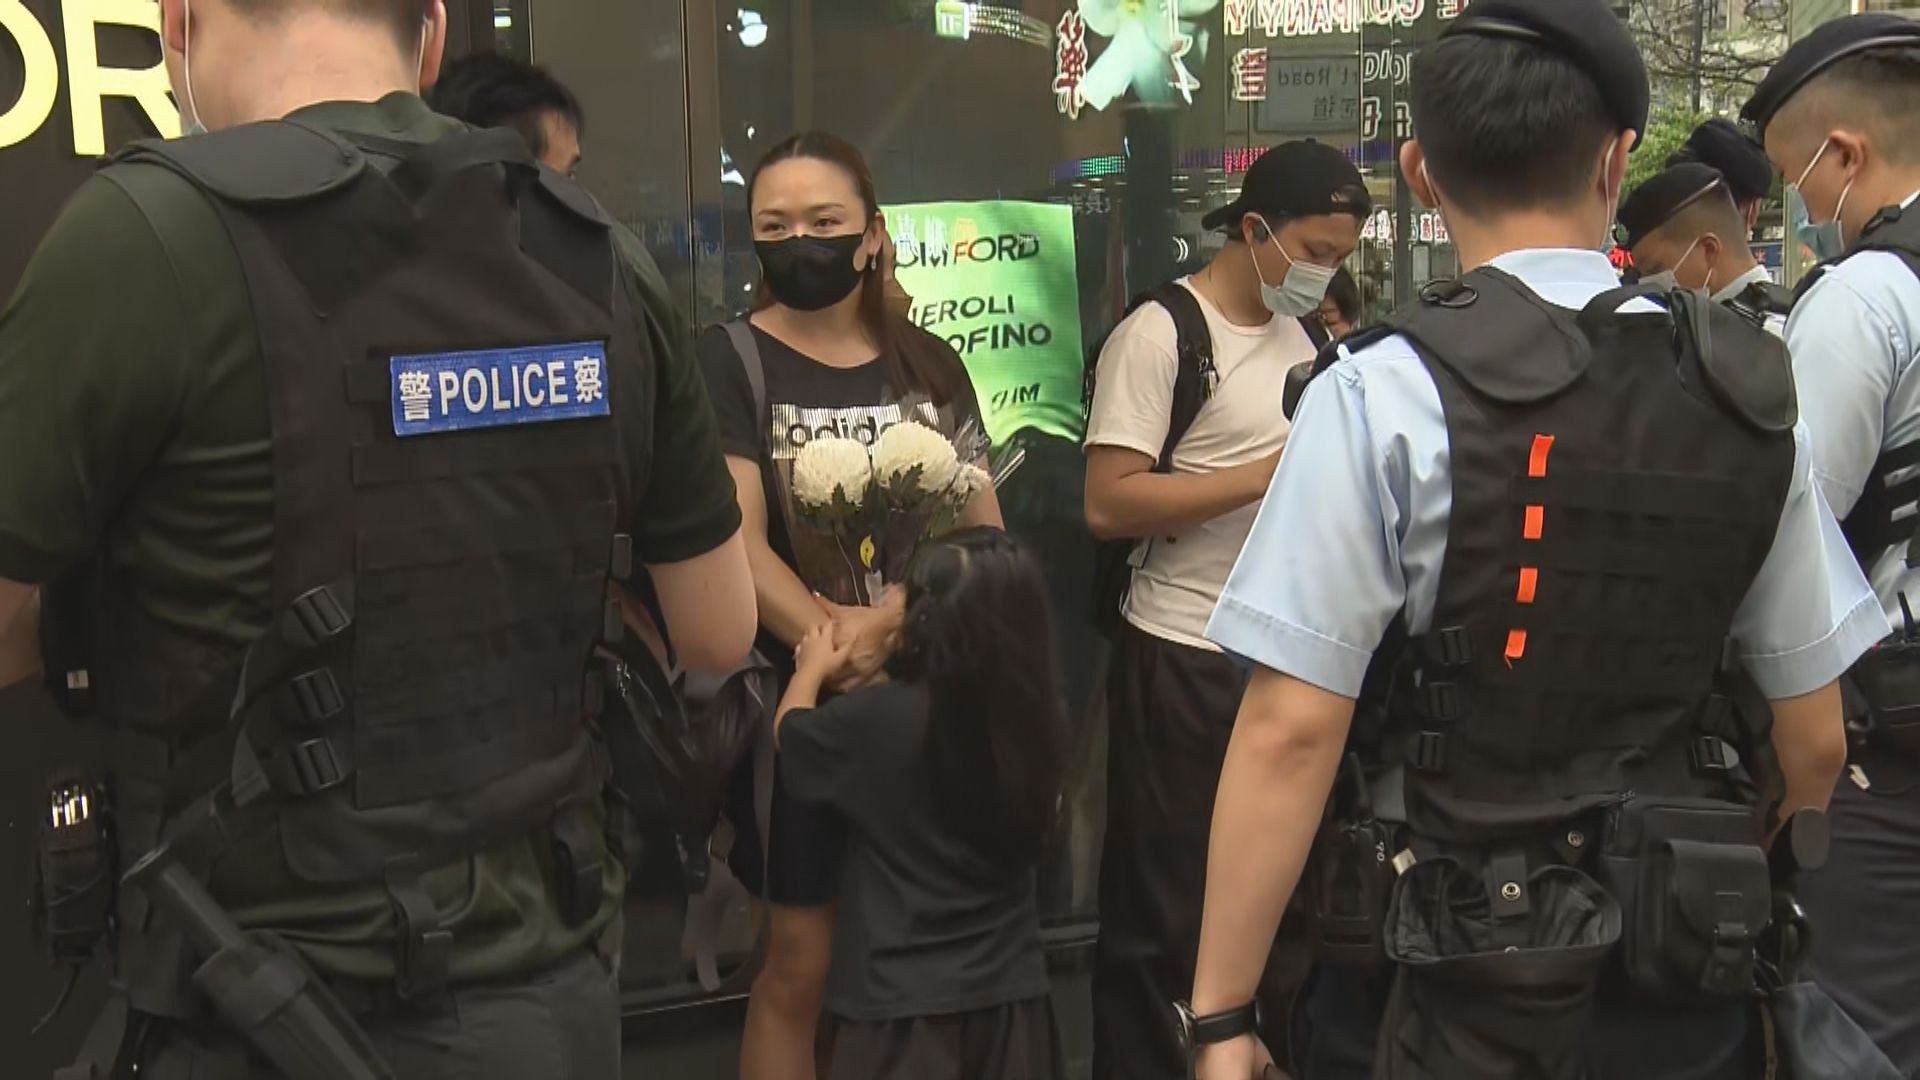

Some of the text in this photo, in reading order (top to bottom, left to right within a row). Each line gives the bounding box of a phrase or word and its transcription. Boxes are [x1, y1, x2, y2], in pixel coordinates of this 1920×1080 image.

[953, 233, 1040, 265] FORD
[948, 323, 1053, 356] OFINO
[399, 355, 602, 422] 警 POLICE 察
[786, 416, 905, 447] adid
